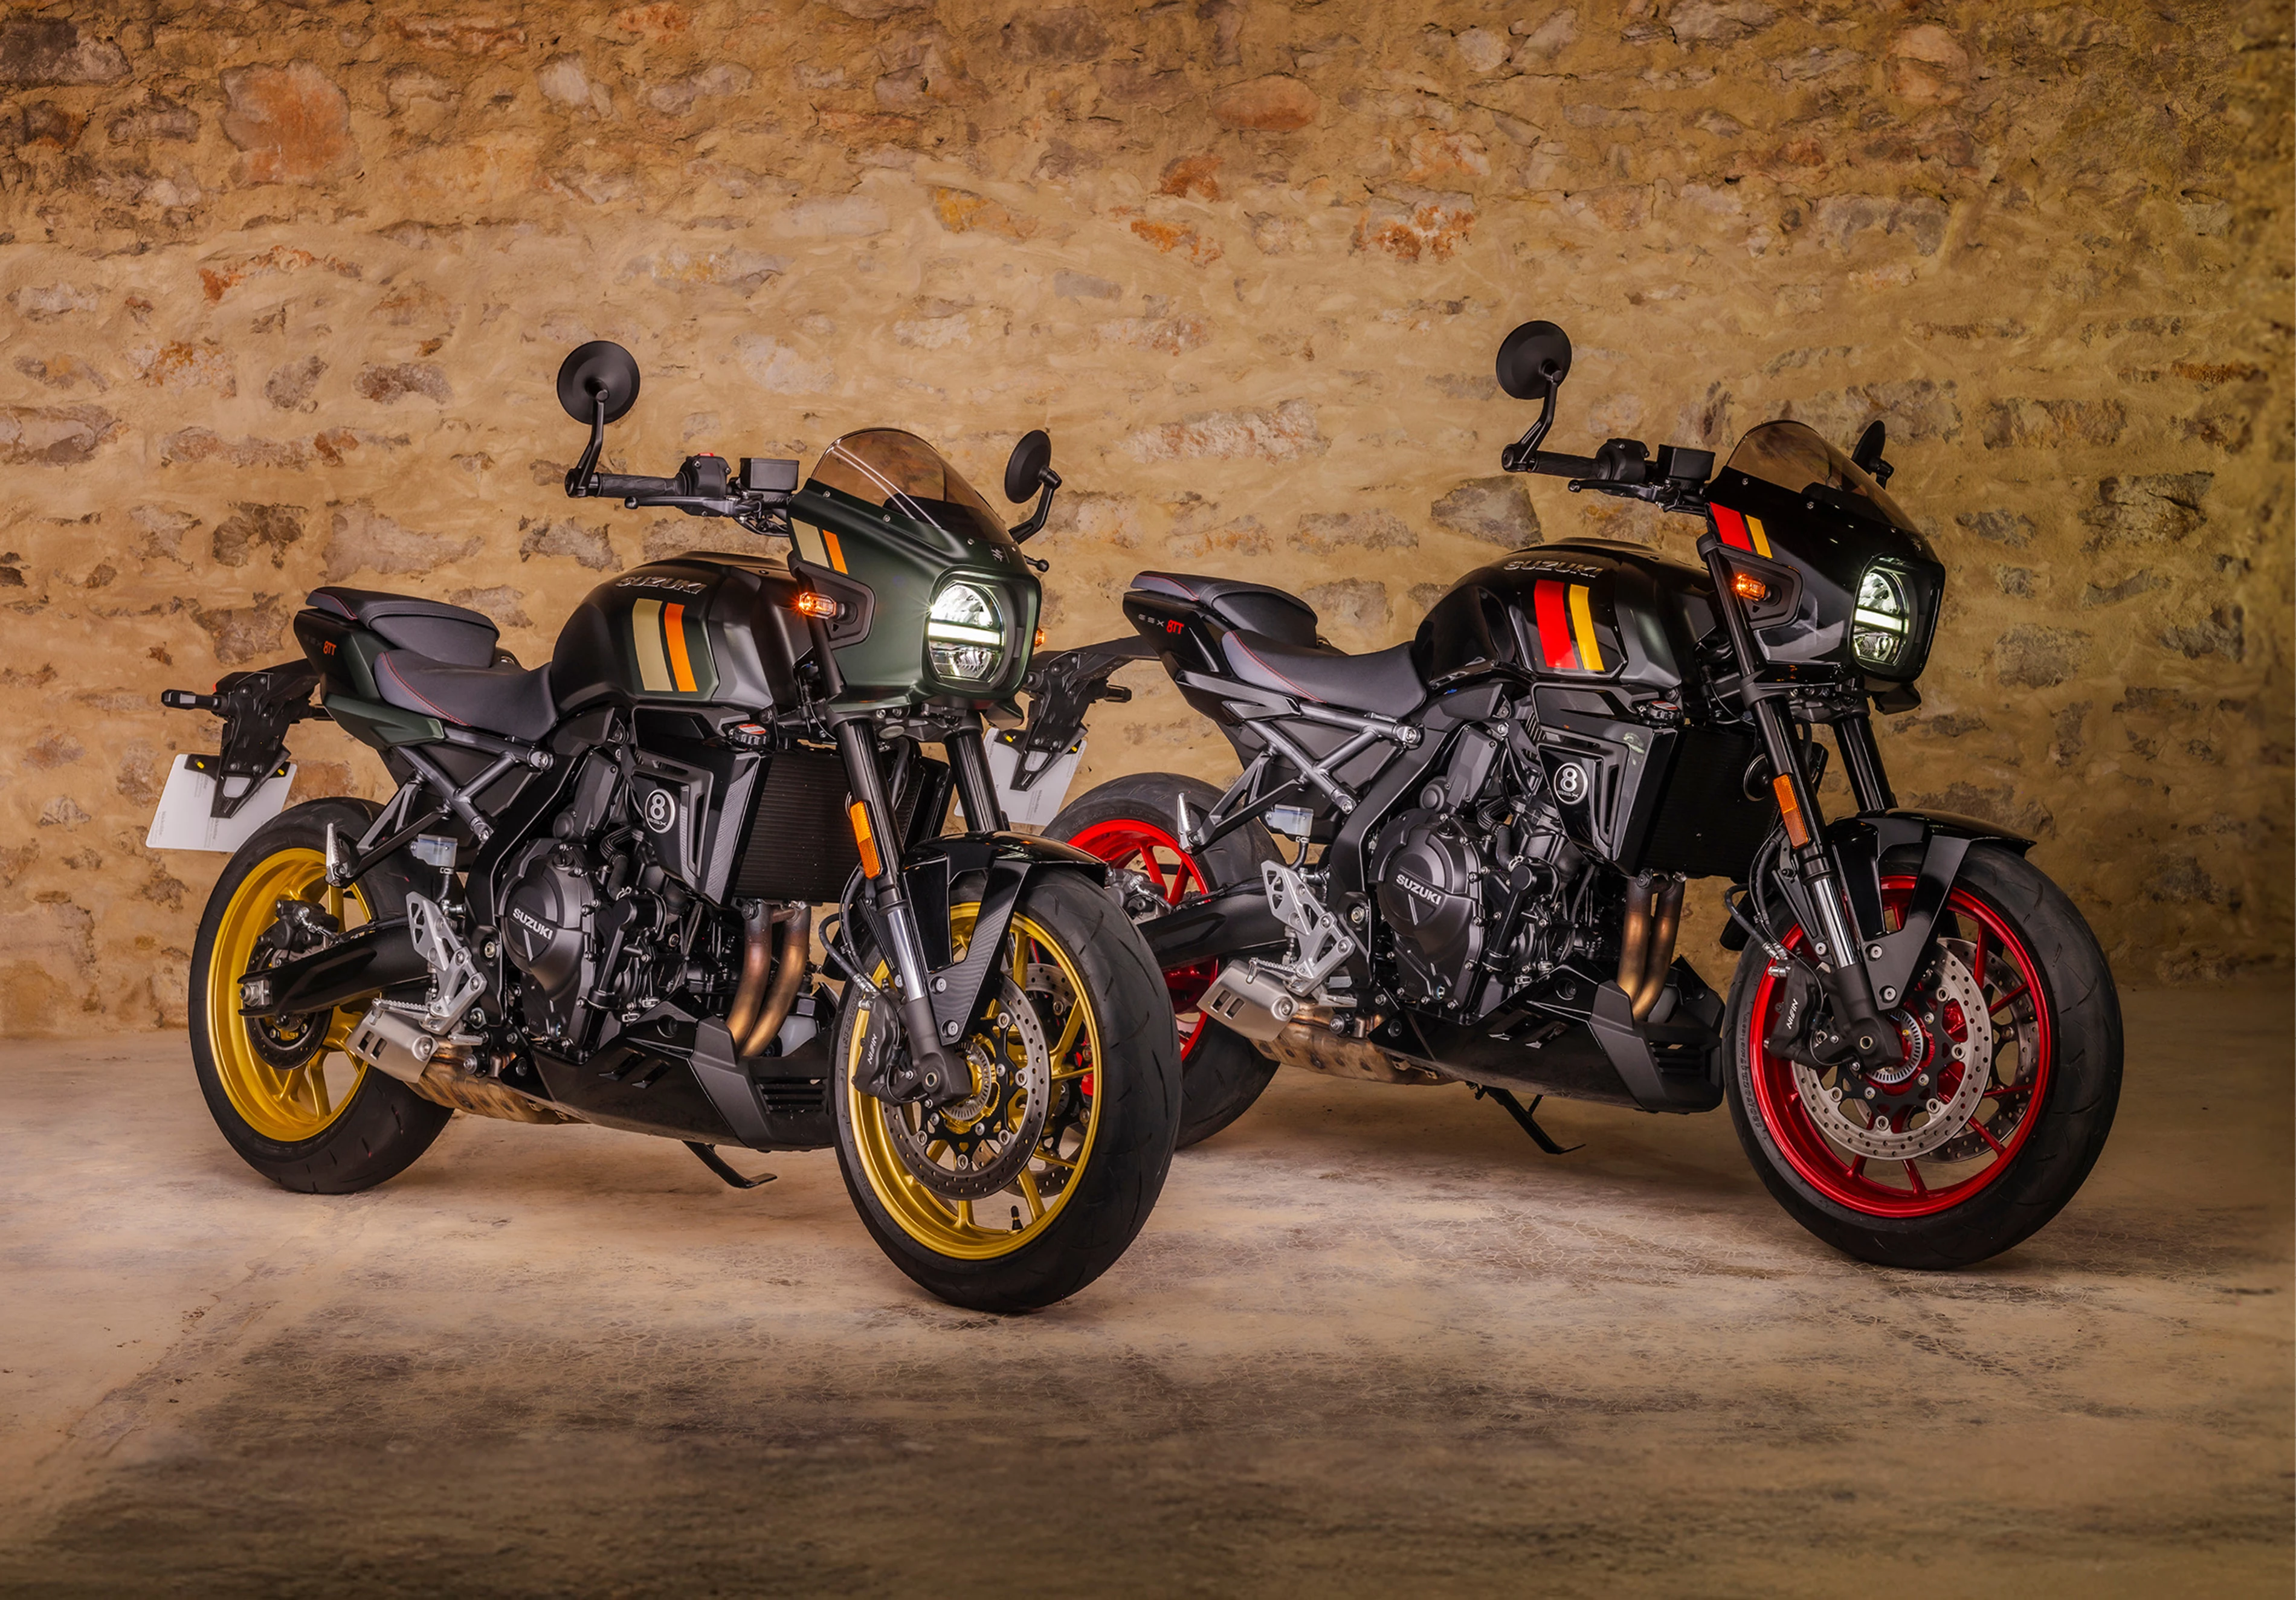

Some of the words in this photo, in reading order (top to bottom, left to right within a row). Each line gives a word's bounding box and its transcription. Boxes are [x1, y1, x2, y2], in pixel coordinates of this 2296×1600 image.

[1504, 560, 1604, 578] SUZUKI
[616, 576, 708, 595] SUZUKI
[1560, 767, 1578, 792] 8
[650, 795, 665, 819] 8
[1396, 874, 1442, 905] SUZUKI
[512, 908, 553, 940] SUZUKI
